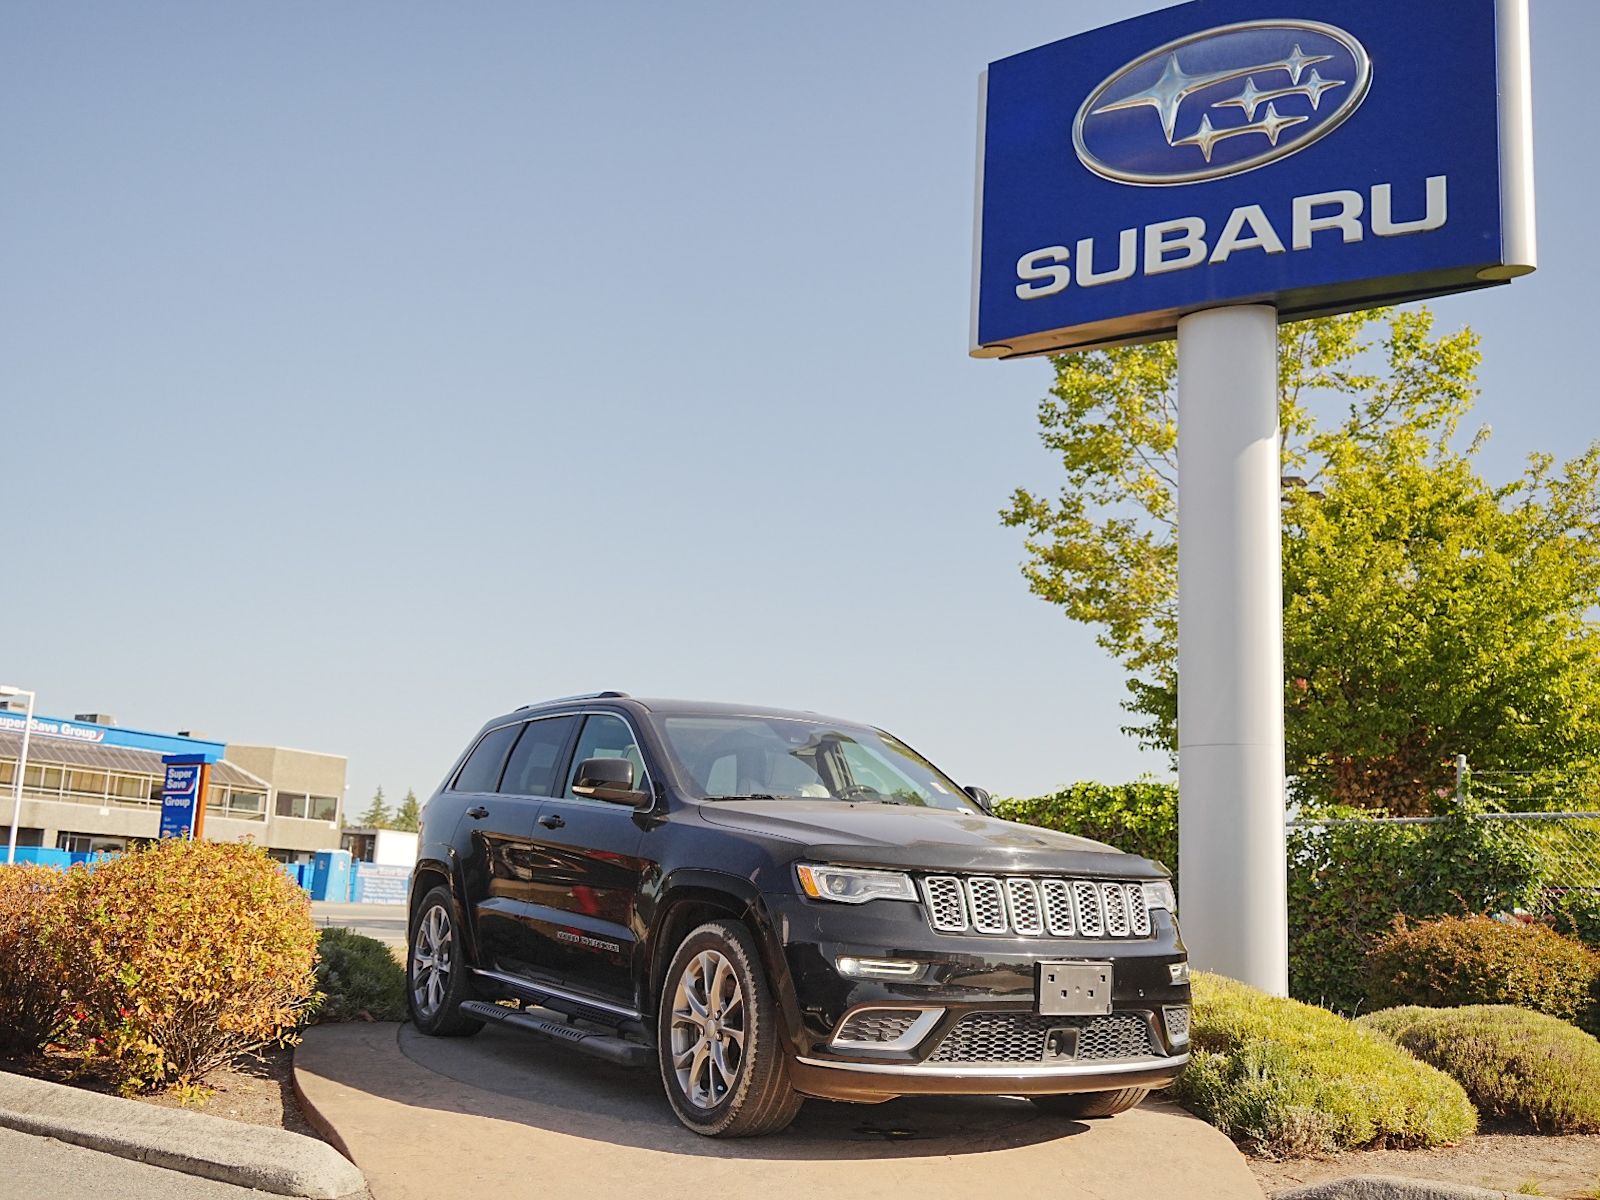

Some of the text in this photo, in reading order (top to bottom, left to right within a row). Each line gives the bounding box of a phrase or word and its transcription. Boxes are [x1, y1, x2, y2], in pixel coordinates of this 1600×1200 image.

[1015, 174, 1448, 301] SUBARU
[0, 717, 97, 739] uper Save Group
[168, 768, 193, 780] Super
[166, 779, 187, 789] Save
[164, 796, 191, 808] Group
